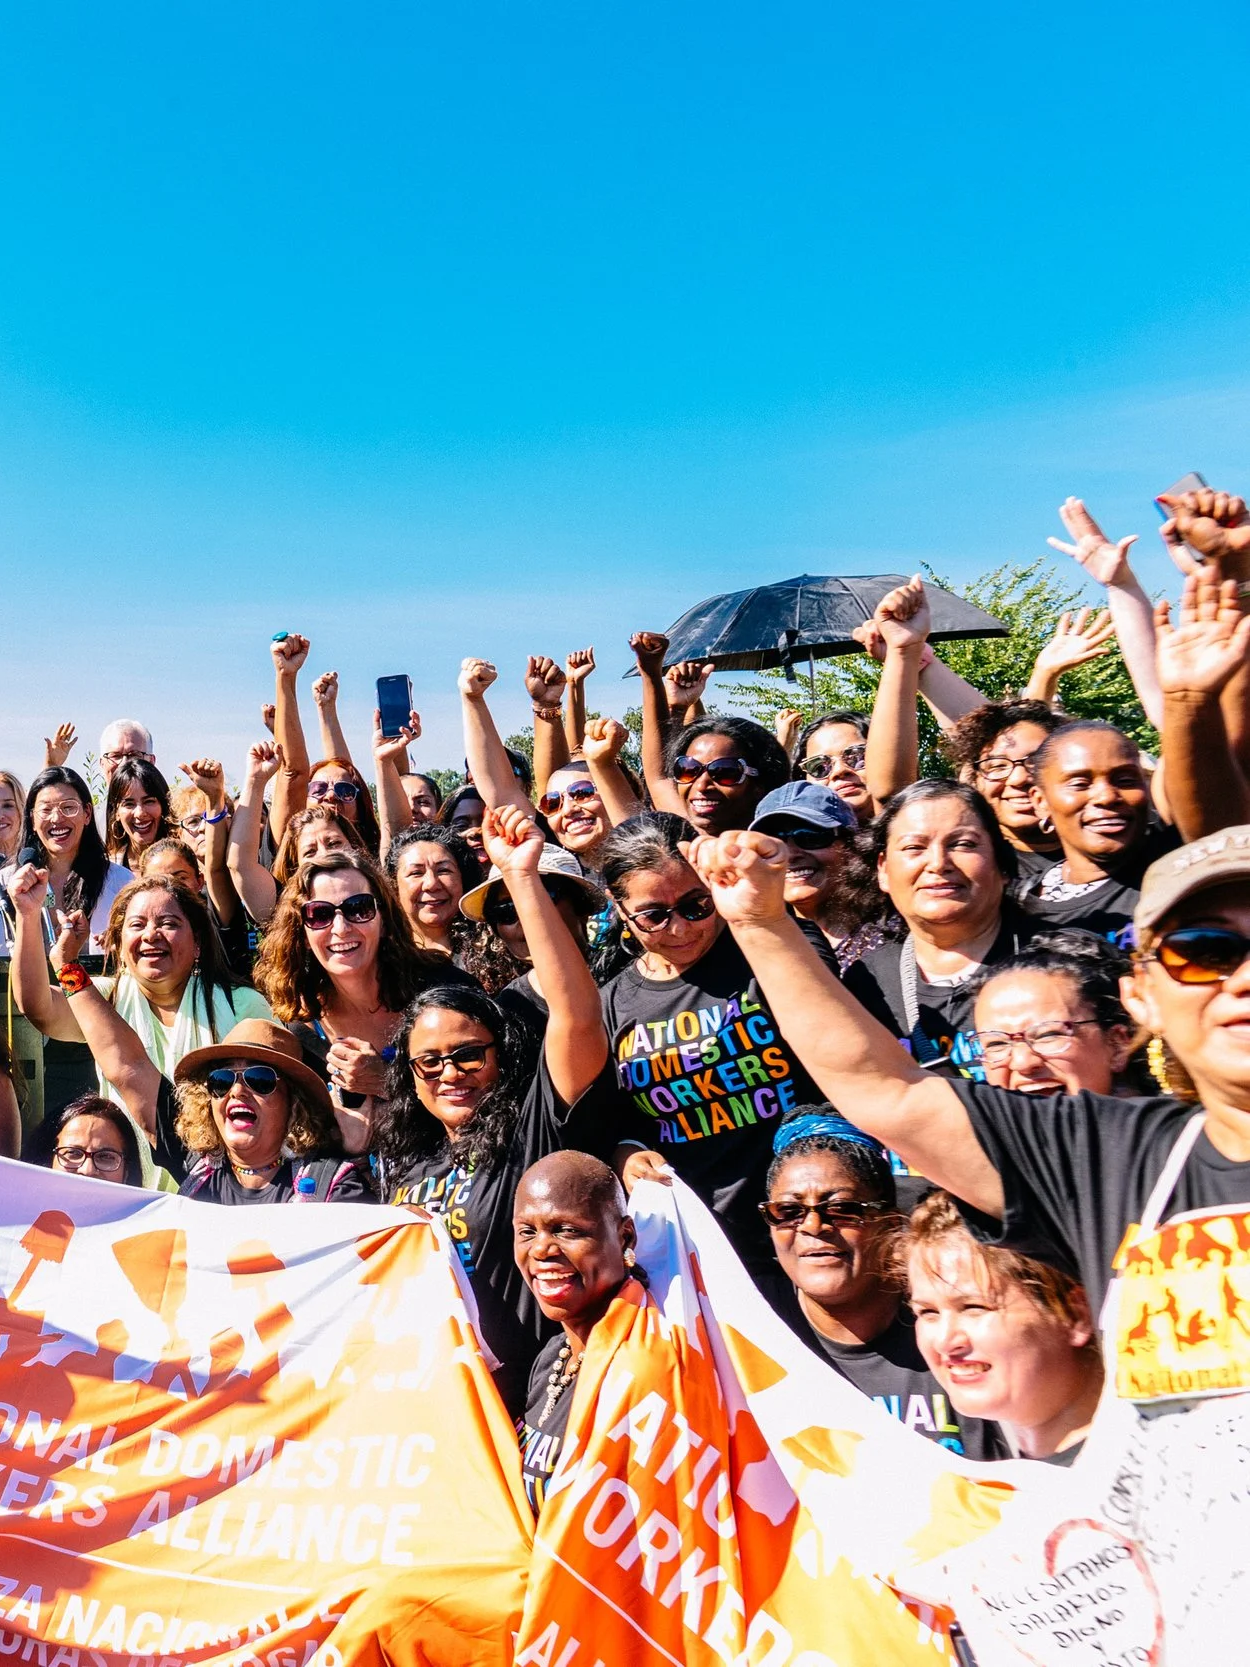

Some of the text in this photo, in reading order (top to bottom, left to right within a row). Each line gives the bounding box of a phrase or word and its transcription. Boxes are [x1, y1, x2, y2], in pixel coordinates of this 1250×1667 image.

[618, 991, 762, 1062] NATIONAL
[654, 1079, 797, 1144] ALLIANCE
[139, 1428, 435, 1489] DOMESTIC
[129, 1489, 422, 1566] ALLIANCE
